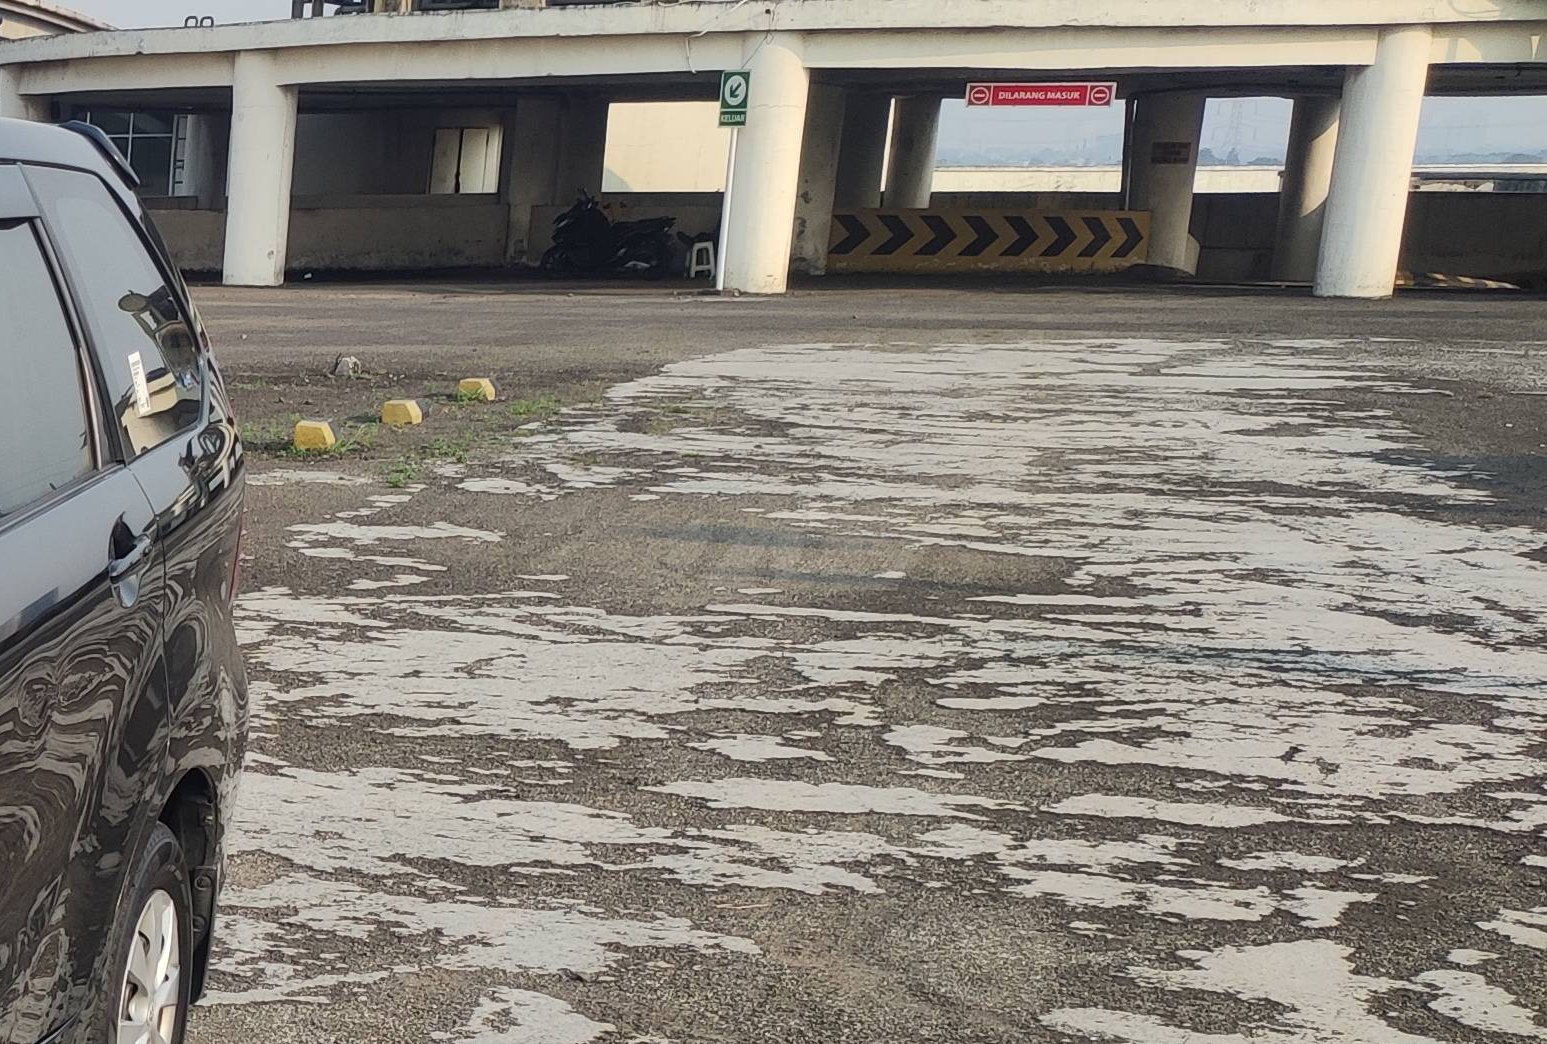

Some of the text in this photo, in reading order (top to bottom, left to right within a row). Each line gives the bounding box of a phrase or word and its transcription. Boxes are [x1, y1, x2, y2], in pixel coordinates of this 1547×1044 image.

[998, 91, 1081, 100] DILARANG MASUK
[720, 113, 746, 122] KELUAR
